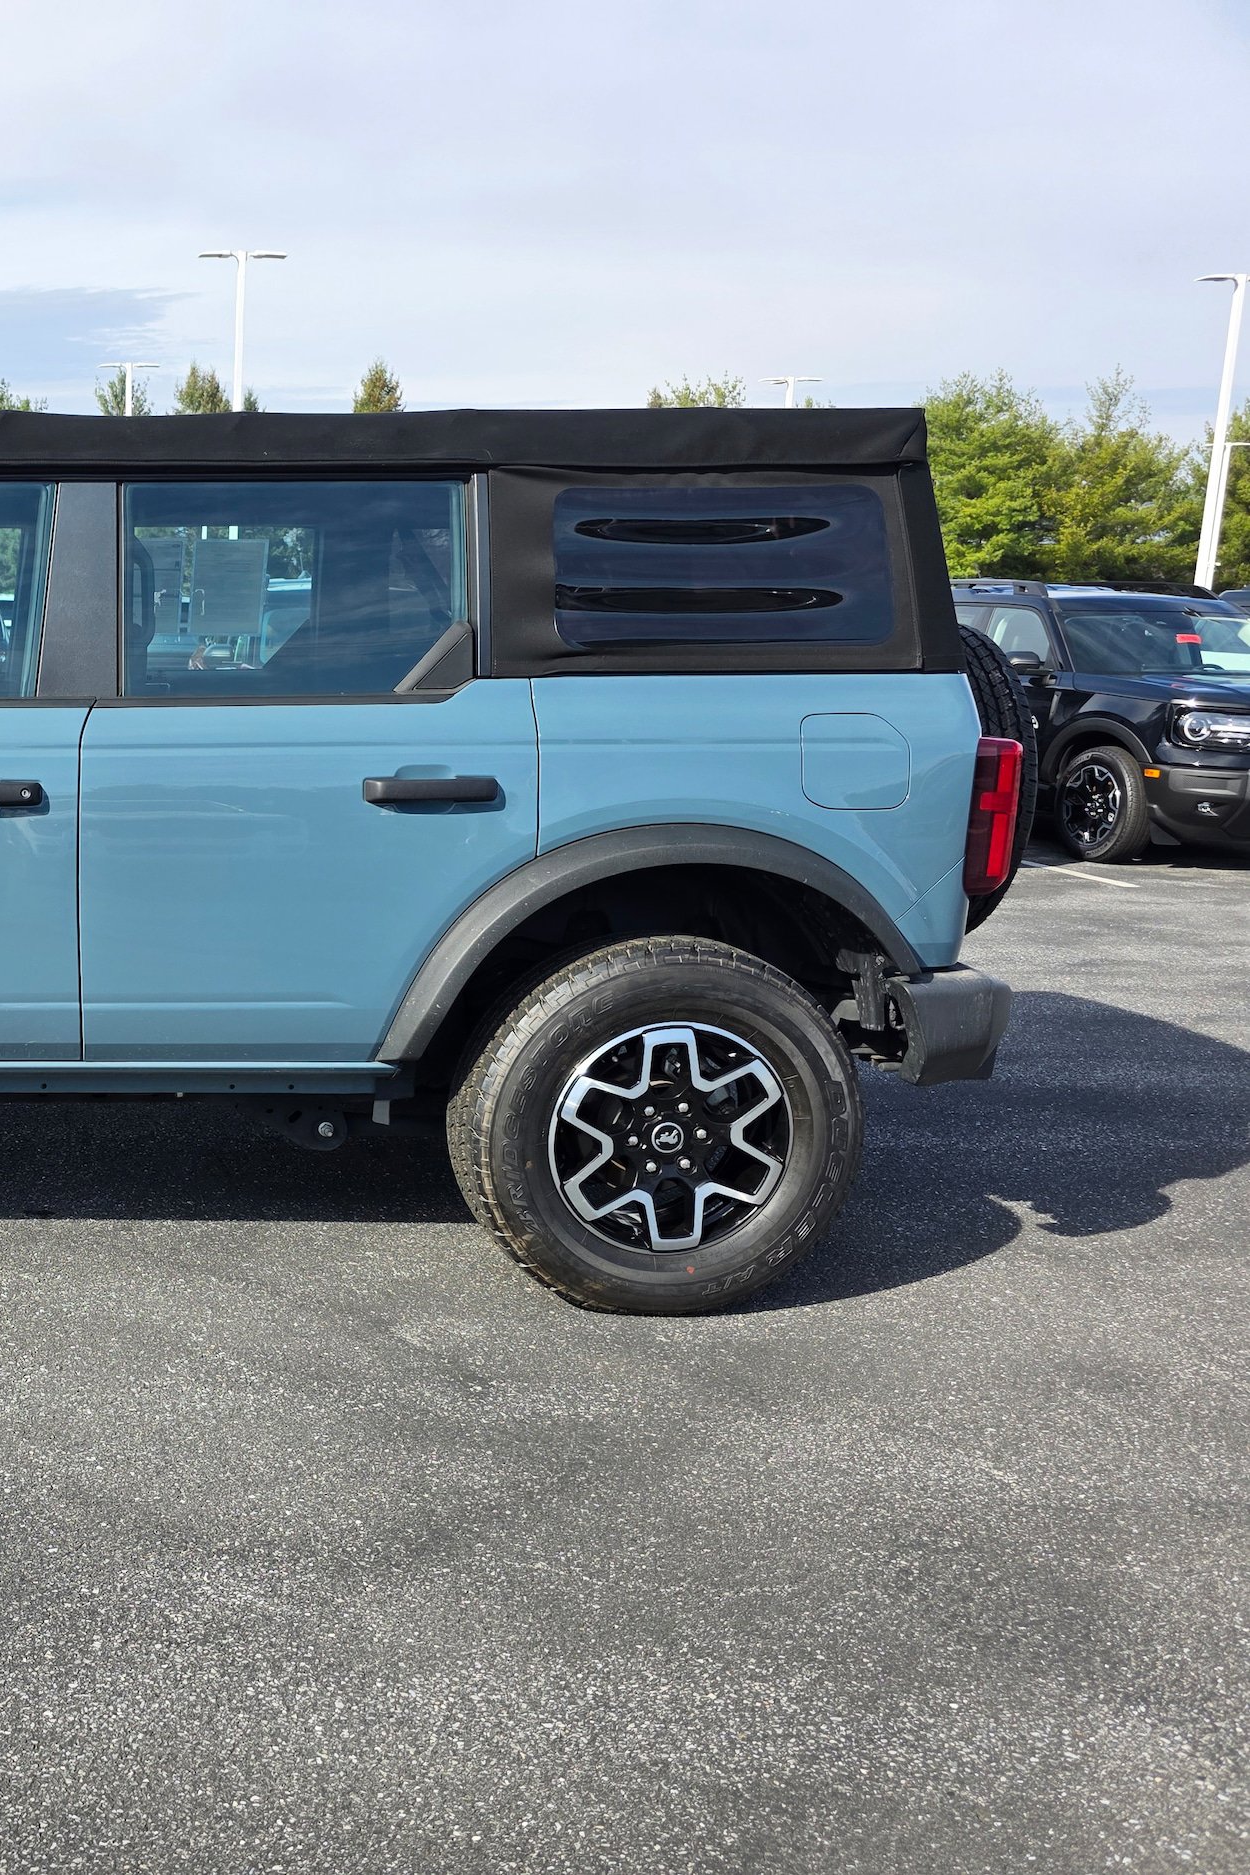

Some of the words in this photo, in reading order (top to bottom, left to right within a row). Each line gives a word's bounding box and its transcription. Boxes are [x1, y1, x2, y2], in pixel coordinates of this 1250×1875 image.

[501, 992, 614, 1235] BRIDGESTONE
[764, 1079, 849, 1268] DUELER
[701, 1264, 758, 1296] A/T
